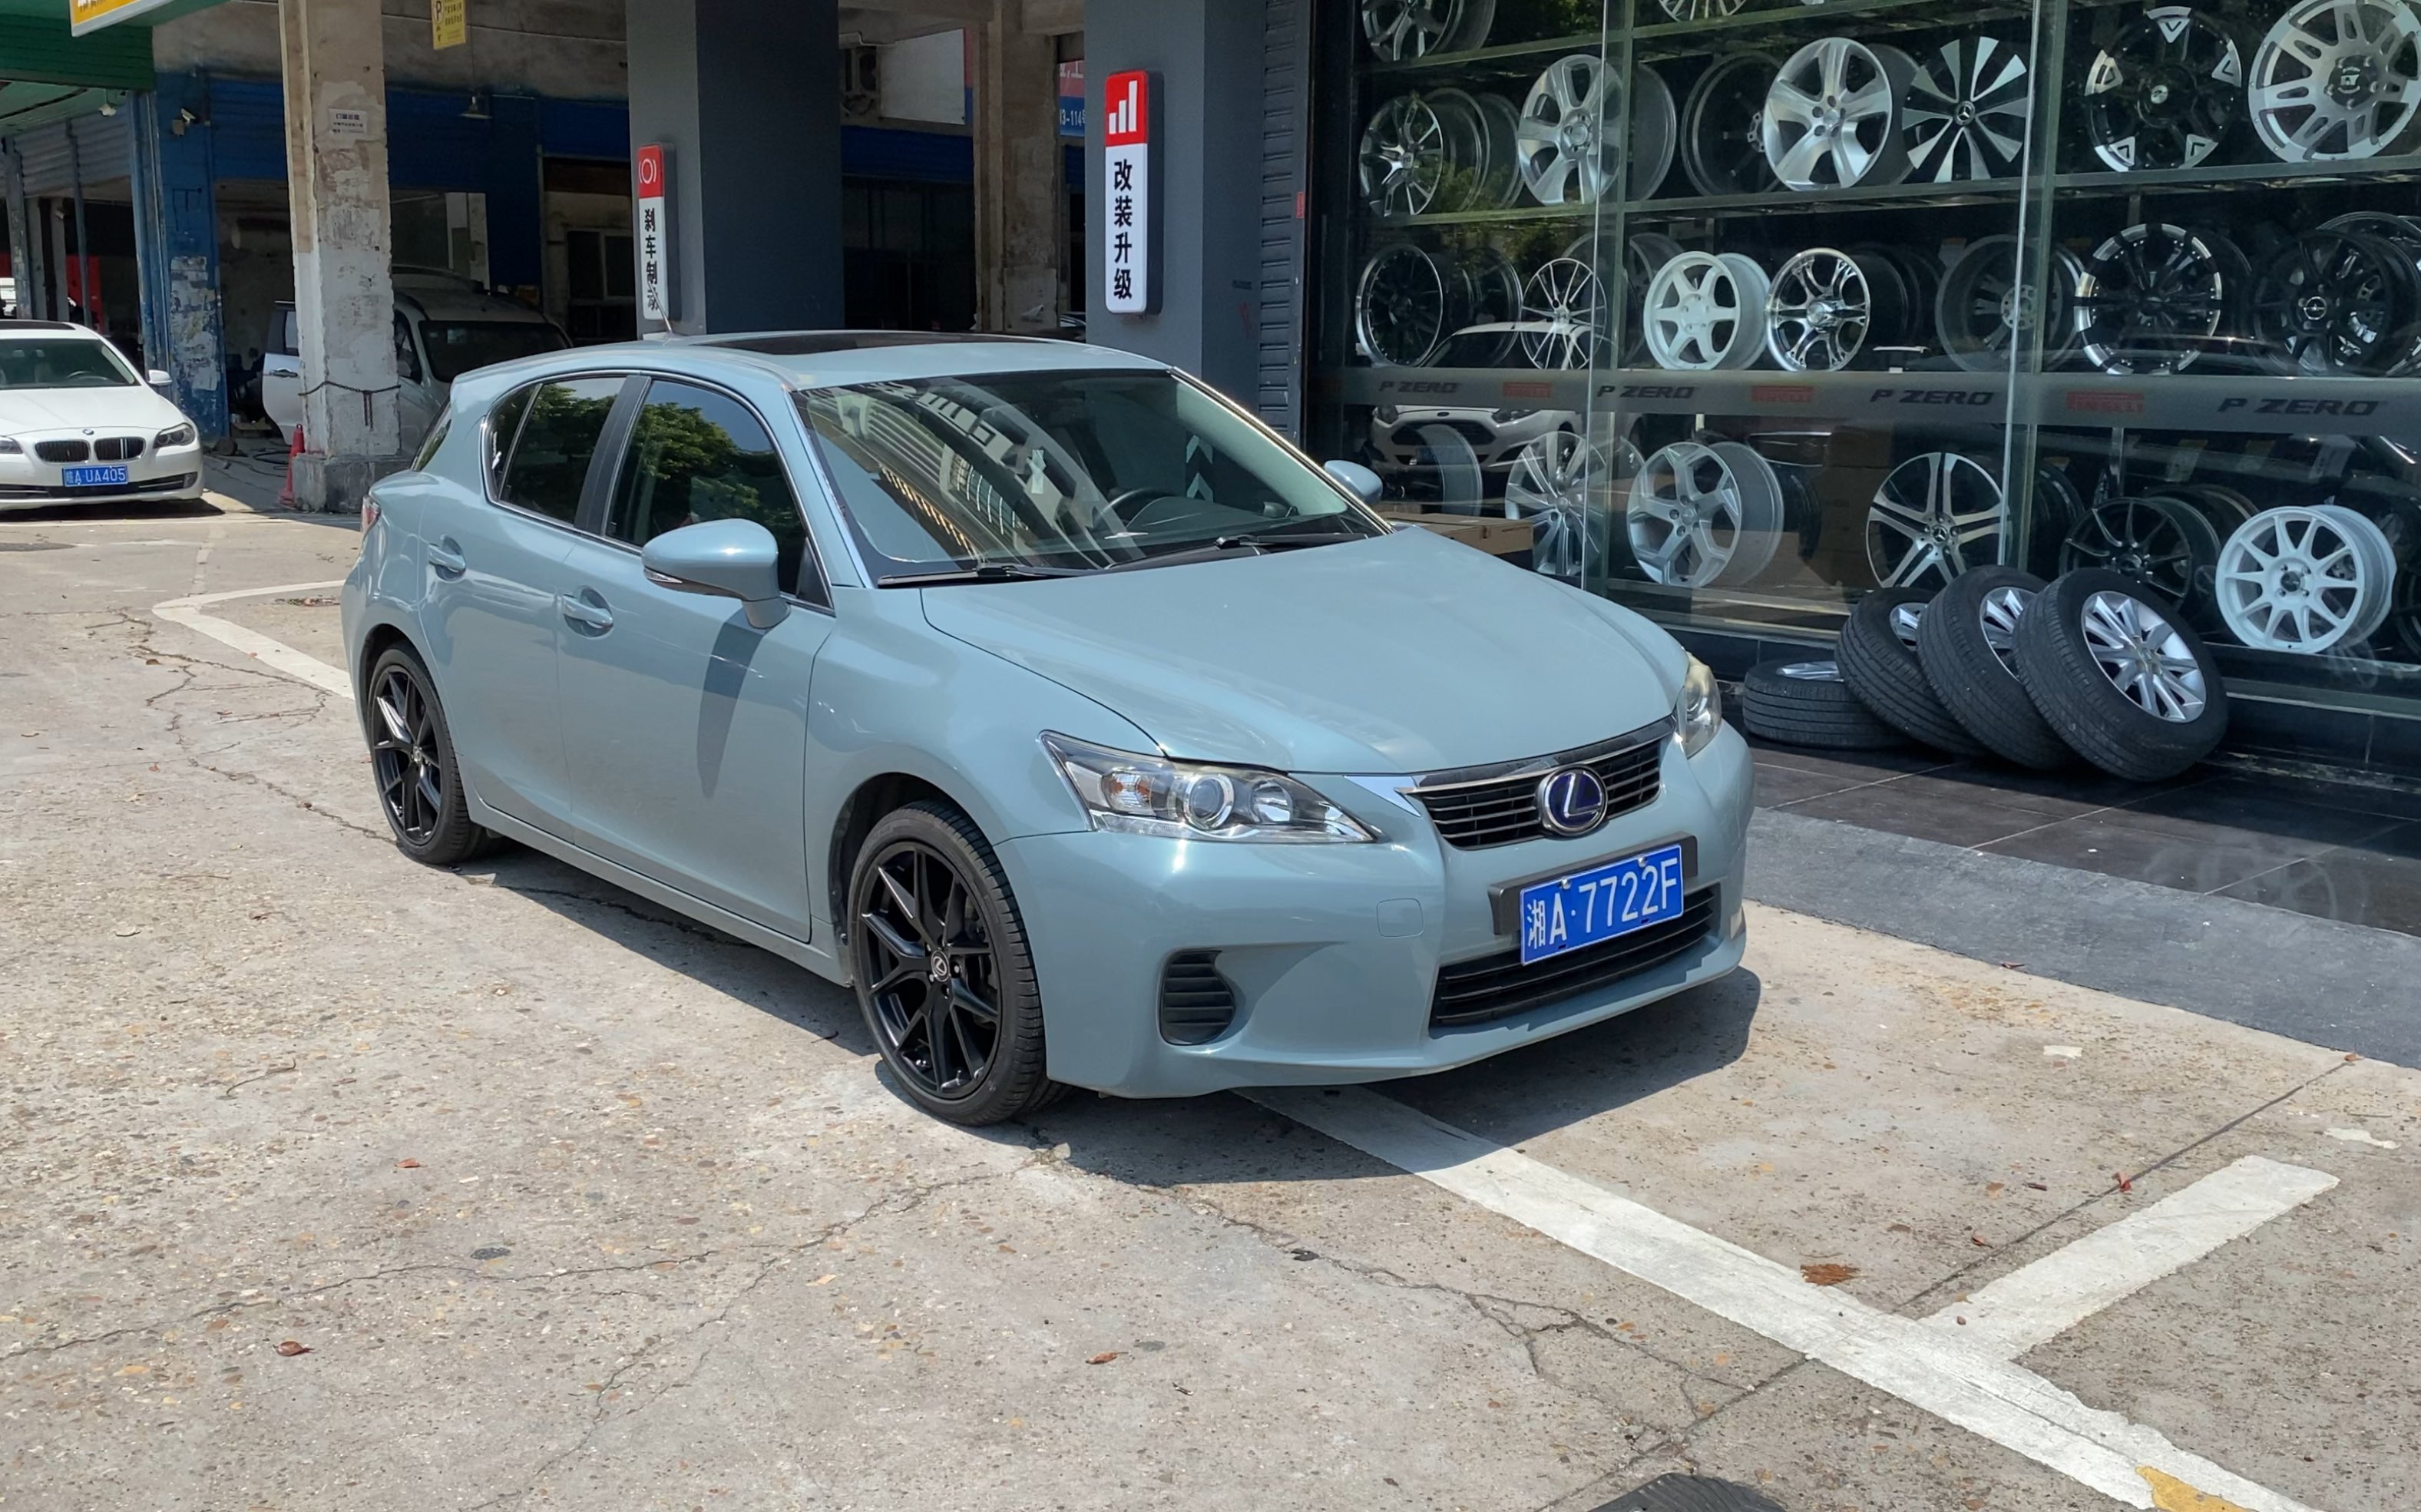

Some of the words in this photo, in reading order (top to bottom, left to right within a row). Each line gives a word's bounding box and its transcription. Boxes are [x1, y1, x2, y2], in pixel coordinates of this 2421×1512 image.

[1113, 158, 1133, 299] 改装升级
[644, 207, 659, 311] 刹车制动
[1397, 382, 1458, 394] ZERO
[1596, 385, 1616, 398] P
[1619, 385, 1695, 399] ZERO
[1869, 389, 1894, 403] P
[1899, 389, 1995, 406] ZERO
[2218, 398, 2247, 412] P
[2254, 398, 2380, 416] ZERO
[1526, 857, 1678, 949] 湘A·7722F
